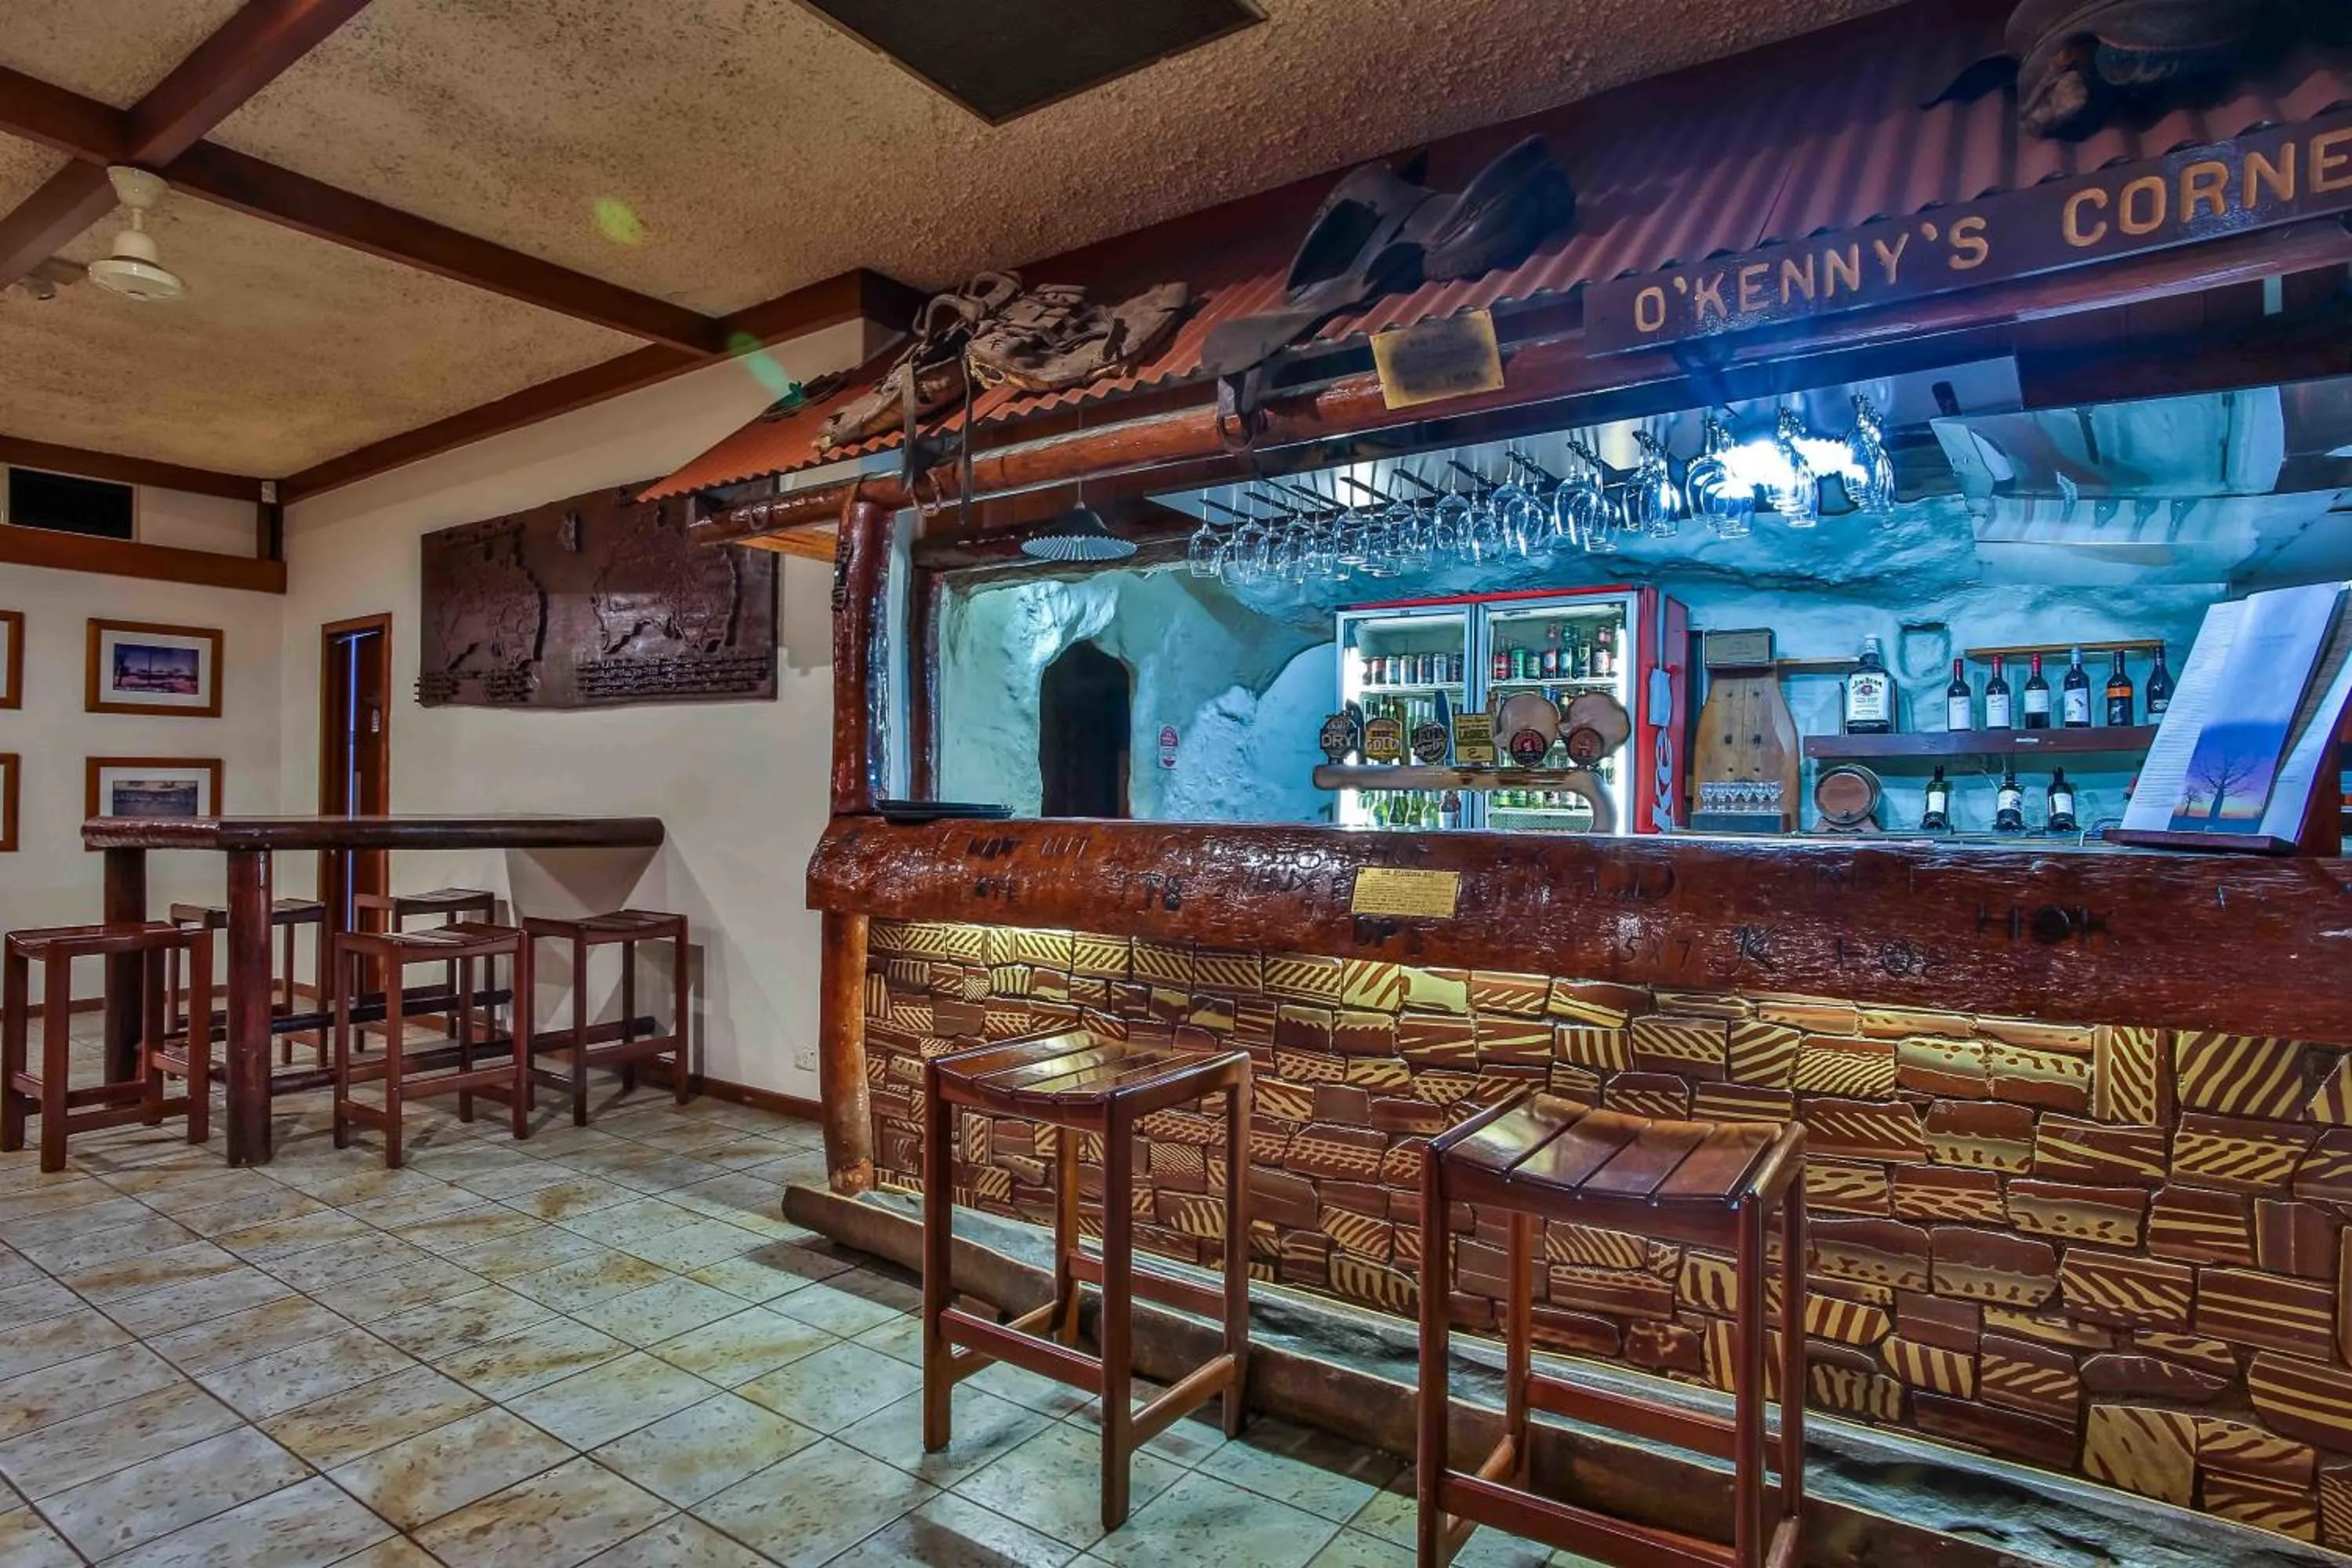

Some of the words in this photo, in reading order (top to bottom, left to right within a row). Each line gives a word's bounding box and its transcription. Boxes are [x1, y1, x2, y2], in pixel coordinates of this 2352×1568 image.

[1633, 216, 1991, 334] O'KENNY'S
[2062, 126, 2352, 249] CORNE
[1321, 733, 1356, 747] DRY
[1367, 737, 1400, 750] GOLD
